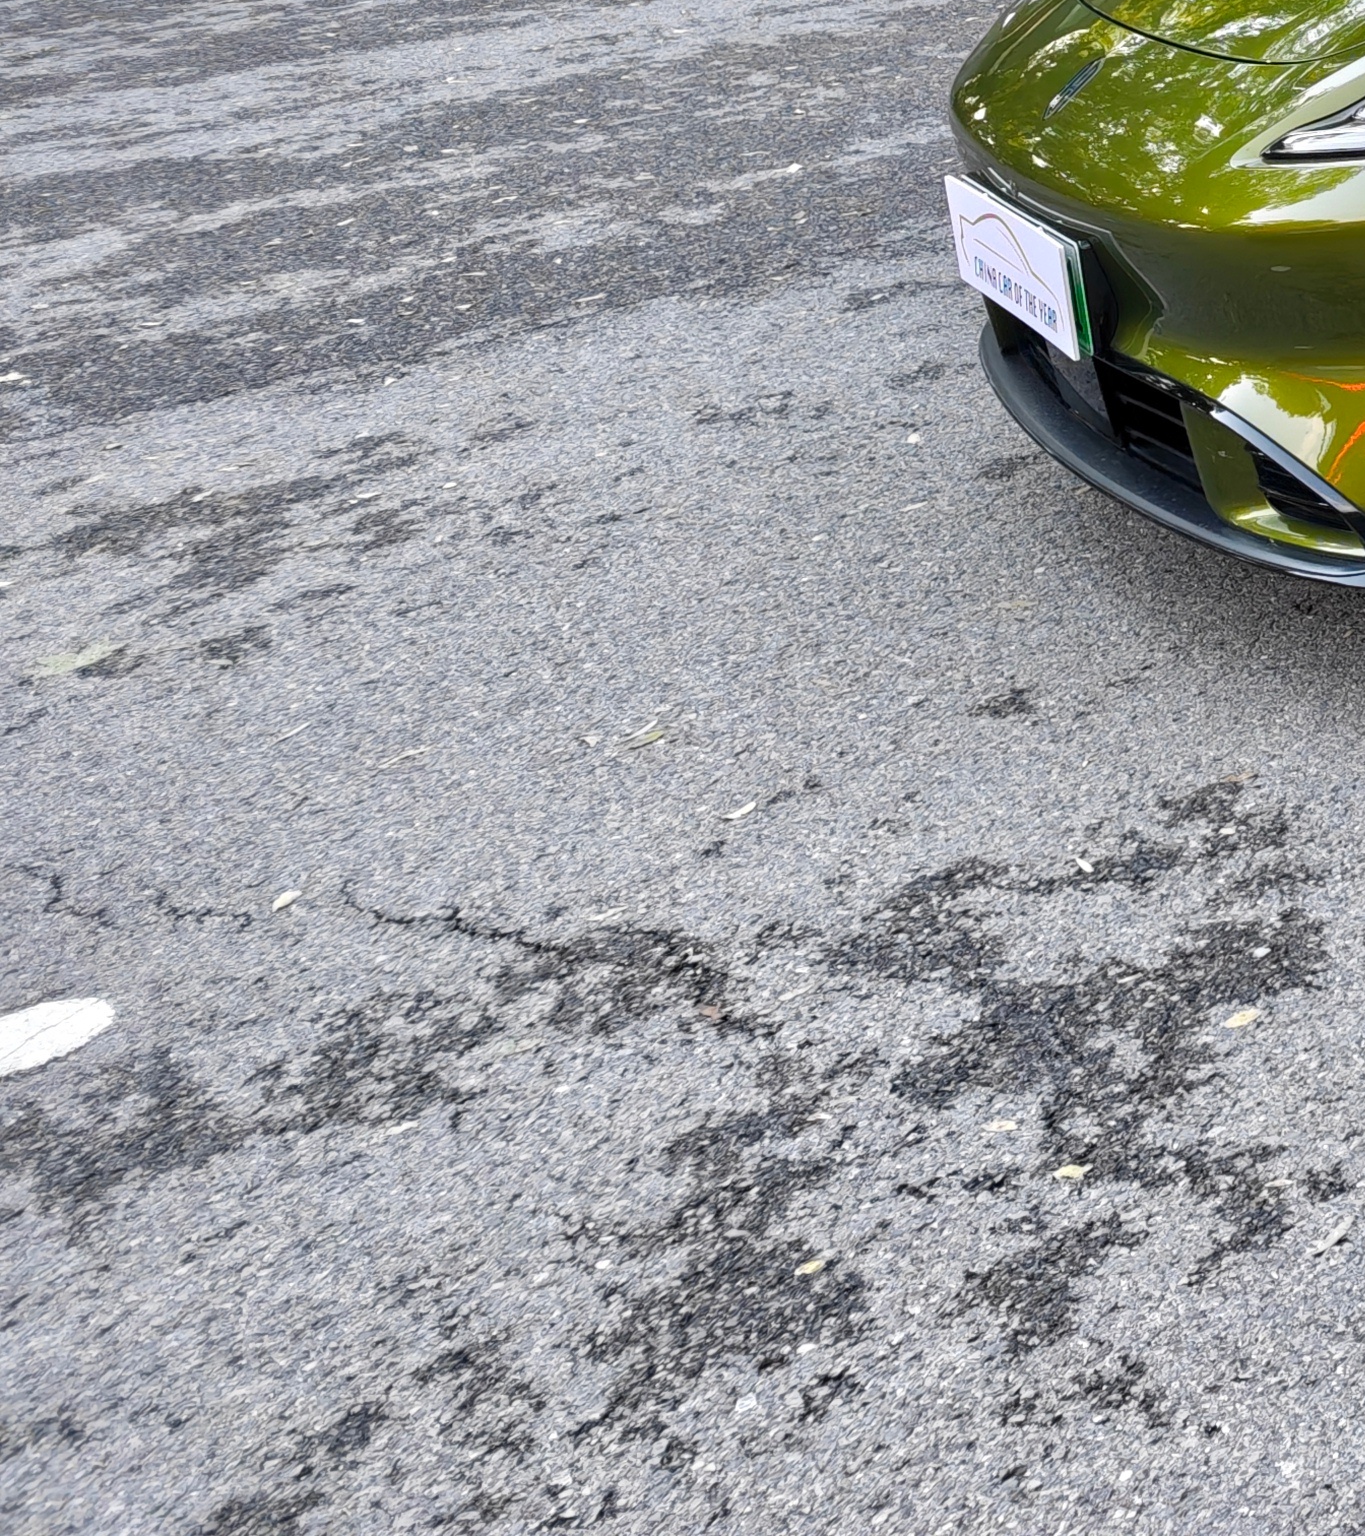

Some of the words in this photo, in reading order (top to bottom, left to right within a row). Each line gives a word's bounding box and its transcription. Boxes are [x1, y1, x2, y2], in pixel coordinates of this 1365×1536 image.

[974, 256, 998, 290] CHINA
[998, 271, 1013, 301] CAR
[1014, 282, 1022, 307] OF
[1024, 288, 1037, 318] THE
[1038, 298, 1058, 333] YEAR
